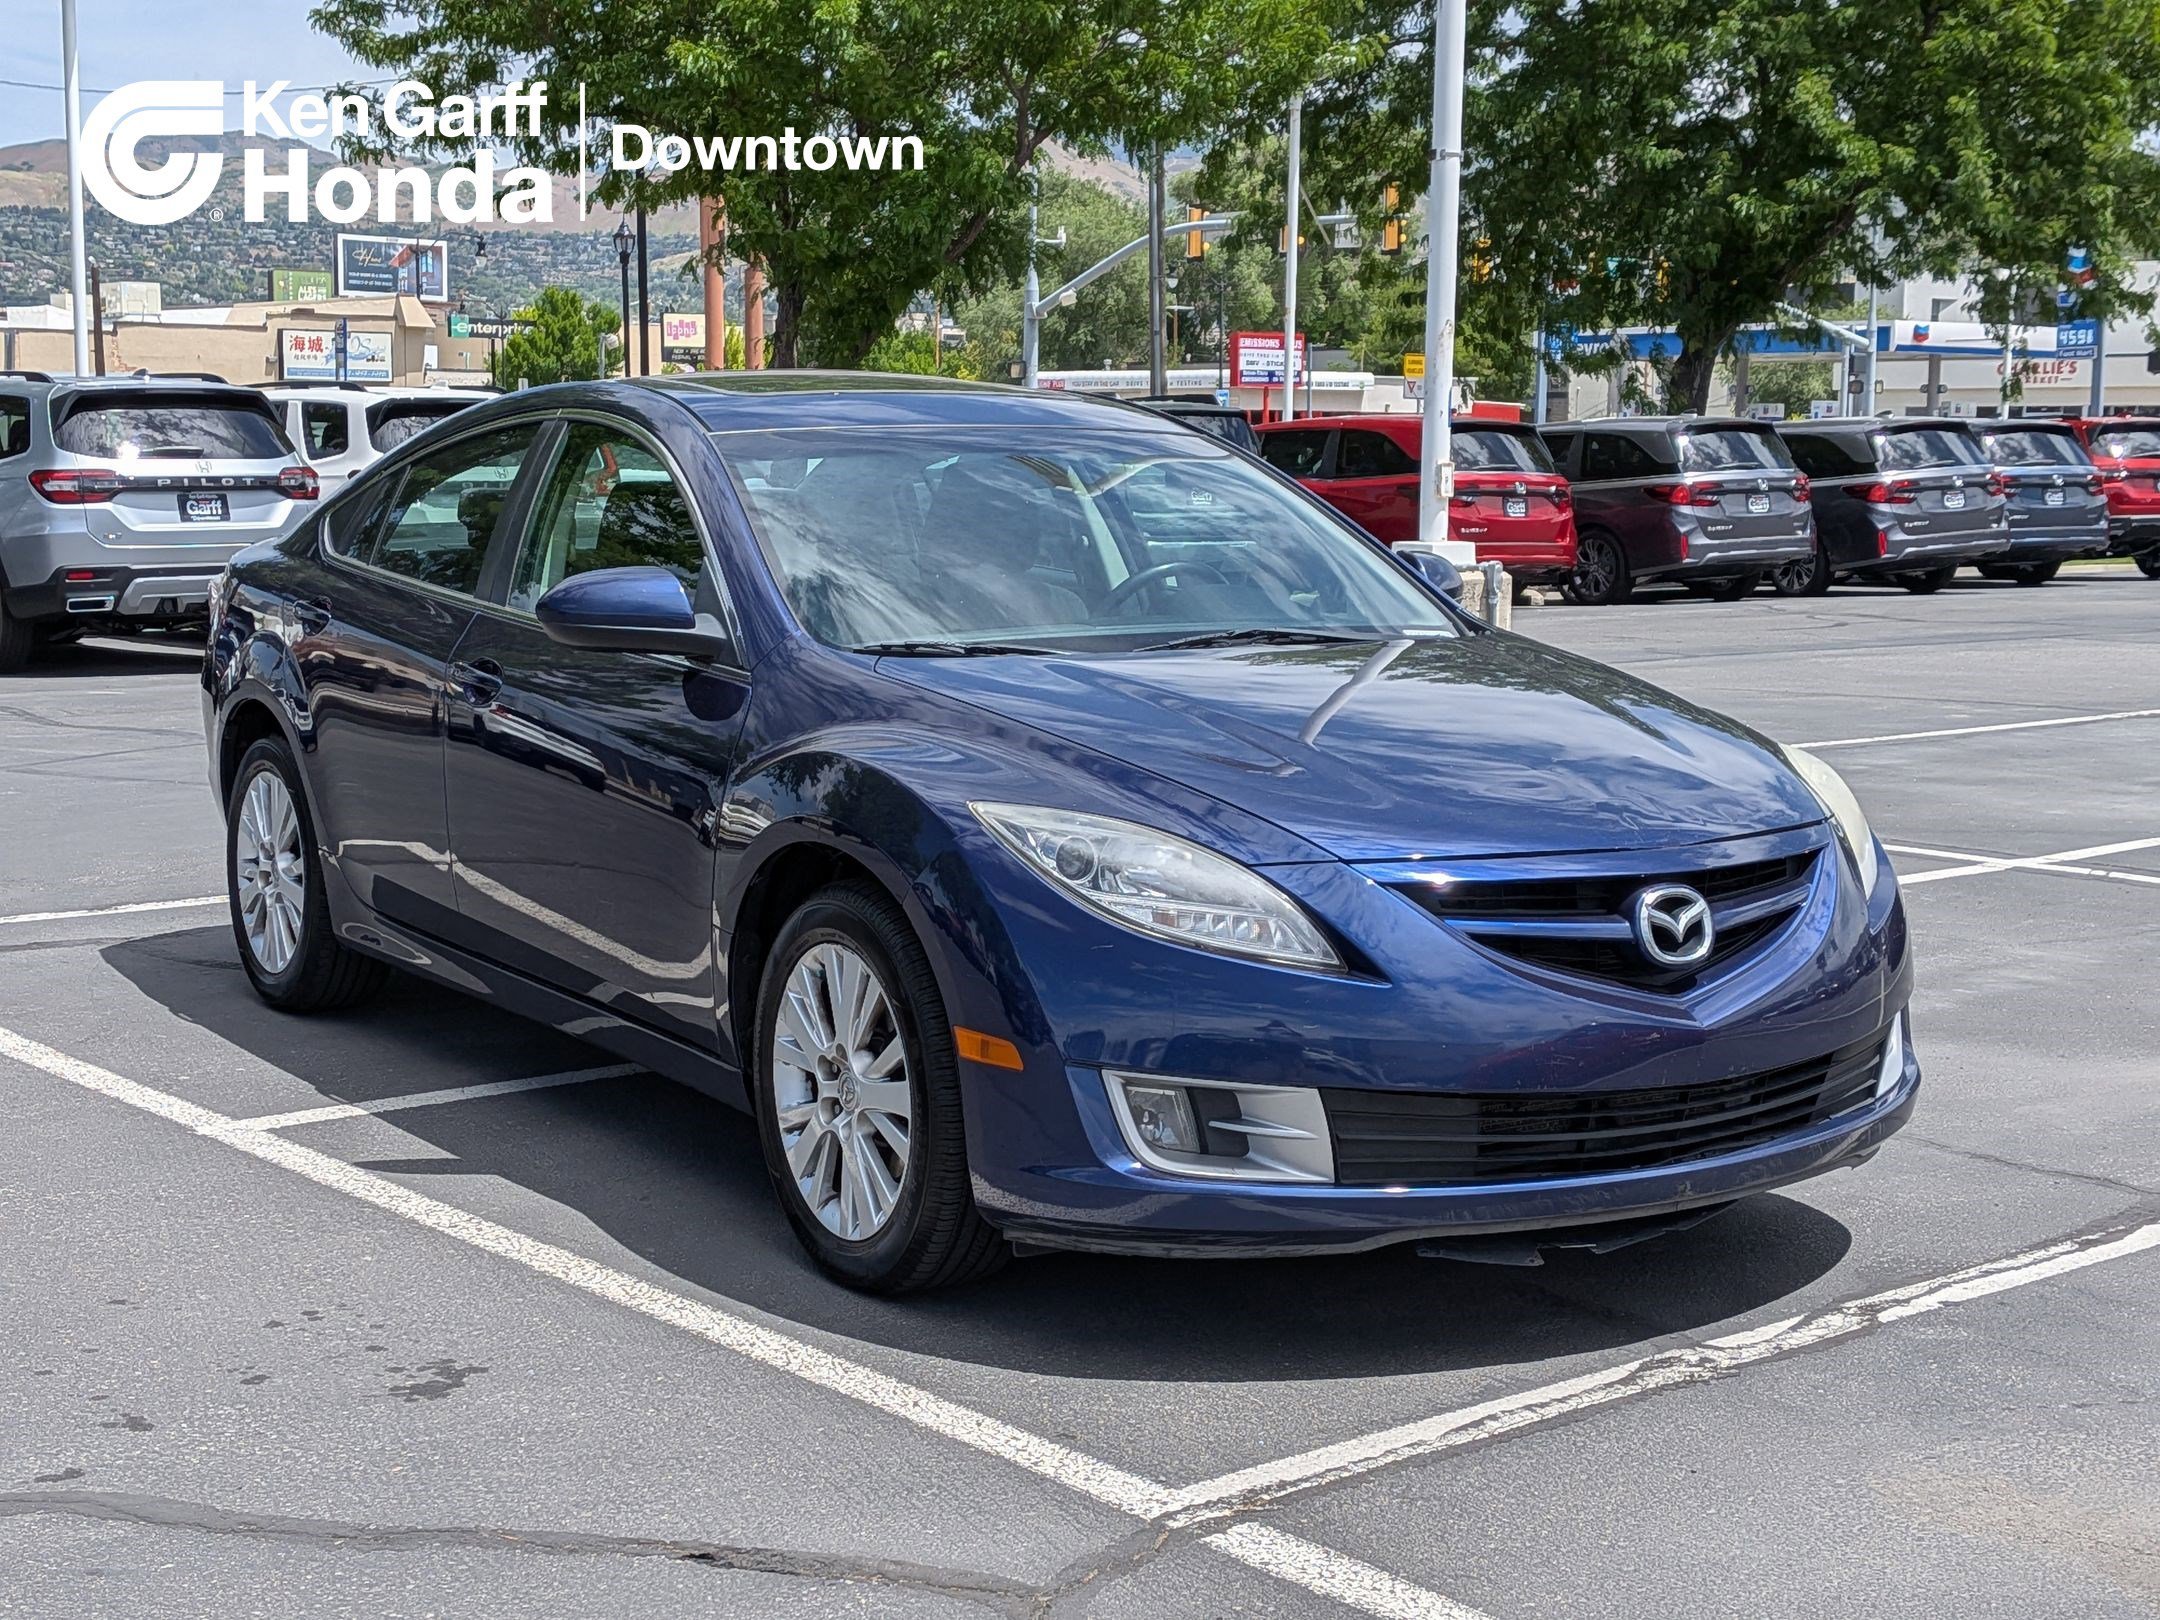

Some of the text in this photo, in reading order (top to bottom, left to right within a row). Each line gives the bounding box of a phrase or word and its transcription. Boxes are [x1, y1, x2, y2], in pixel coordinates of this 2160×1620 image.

[289, 335, 324, 353] 海城
[1240, 337, 1280, 349] EMISSIONS
[157, 477, 256, 488] PILOT
[186, 499, 223, 515] Garff
